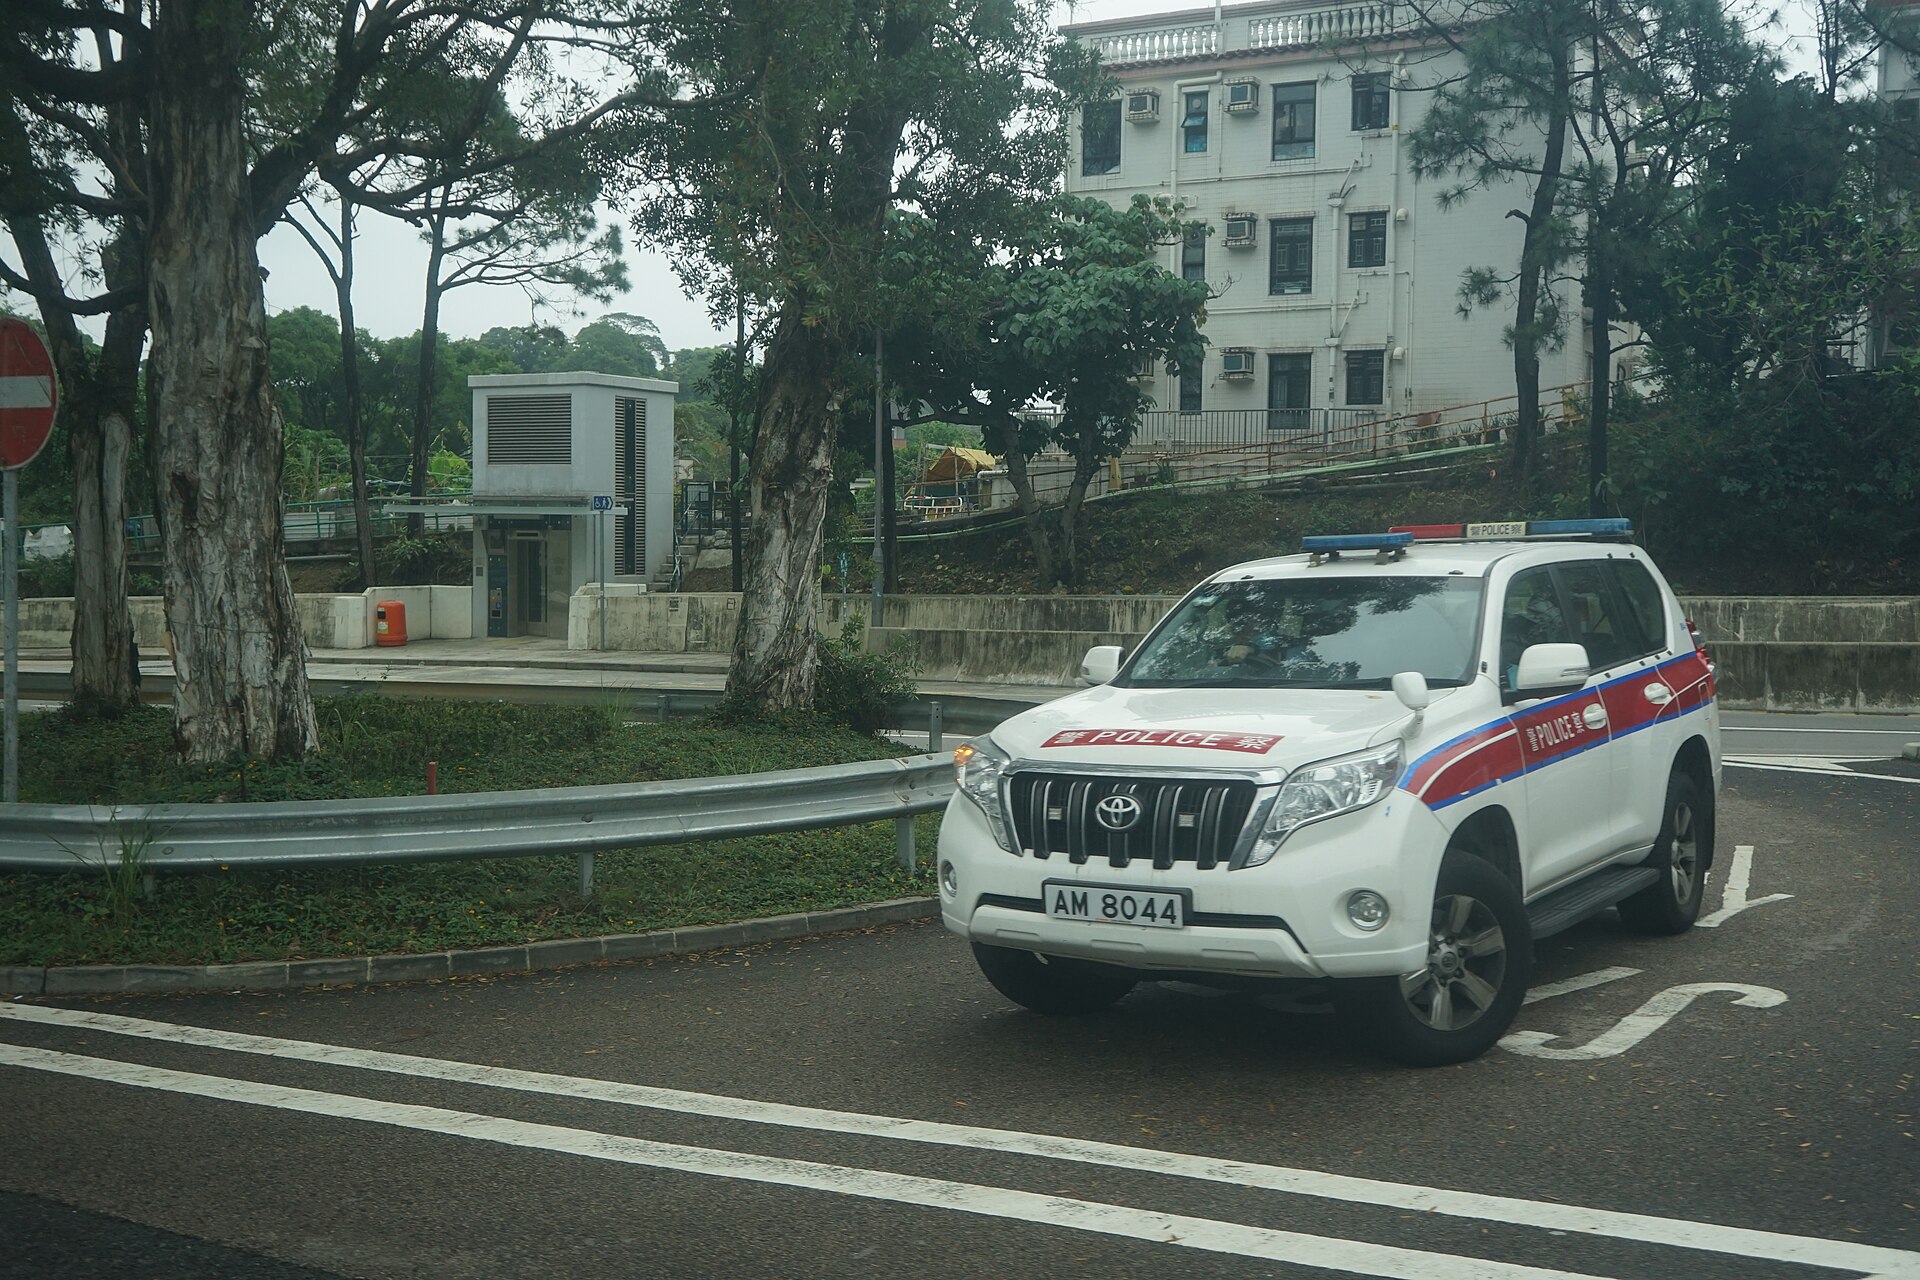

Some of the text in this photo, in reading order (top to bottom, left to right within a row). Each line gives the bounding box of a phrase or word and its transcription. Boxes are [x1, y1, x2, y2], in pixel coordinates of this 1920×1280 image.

[1482, 524, 1510, 535] POLICE
[1511, 523, 1522, 534] 察
[1055, 730, 1274, 750] 警 POLICE 察
[1535, 715, 1575, 749] POLICE
[1053, 889, 1177, 924] AM 8044
